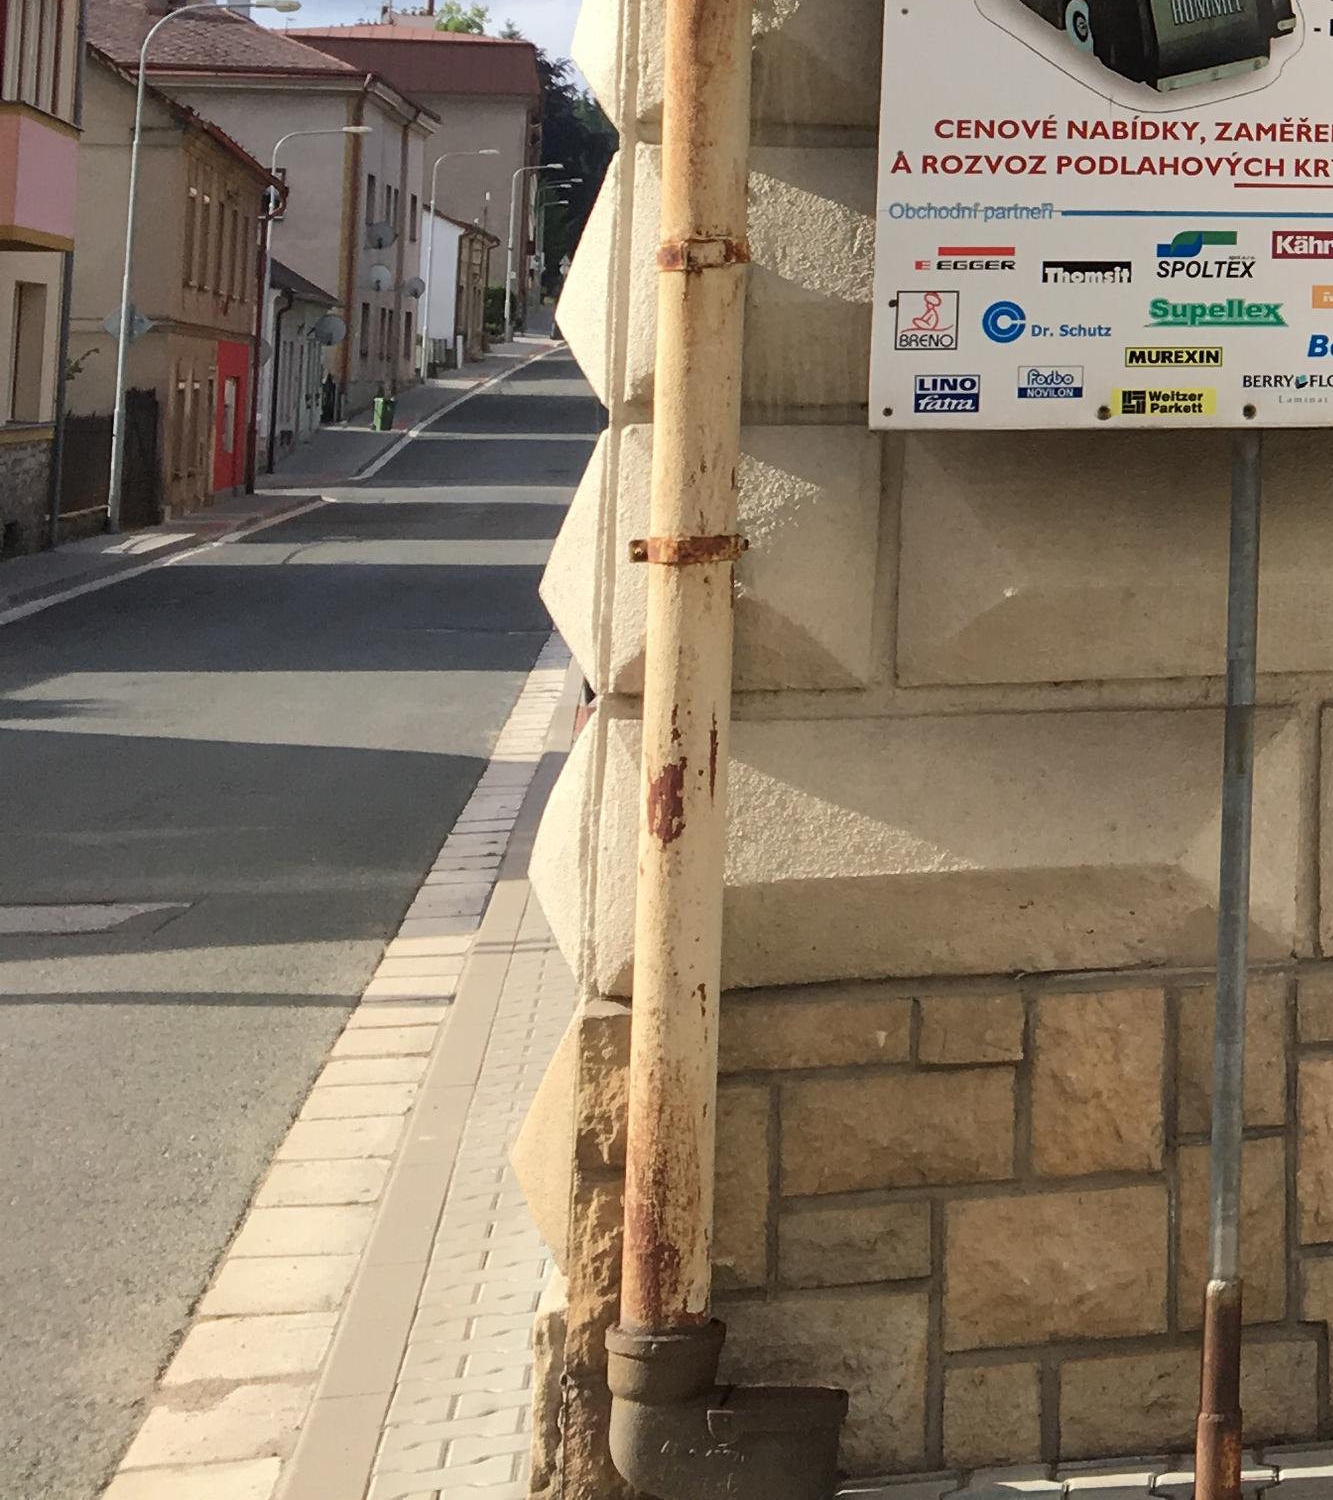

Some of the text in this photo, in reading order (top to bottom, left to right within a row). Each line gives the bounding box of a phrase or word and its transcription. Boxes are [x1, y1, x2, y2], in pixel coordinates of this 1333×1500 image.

[933, 114, 1058, 140] CENOVÉ
[1066, 115, 1206, 145] NABÍDKY,
[890, 154, 912, 175] A
[921, 154, 1047, 175] ROZVOZ
[1056, 152, 1285, 177] PODLAHOVÝCH
[888, 201, 981, 220] Obchodní
[936, 260, 1016, 271] EGGER
[1156, 260, 1256, 279] SPOLTEX
[1044, 266, 1131, 284] Thomsit
[1148, 297, 1286, 326] Supellex
[1031, 324, 1112, 338] Dr. Schutz
[898, 333, 954, 348] BRENO
[1127, 349, 1220, 365] MUREXIN
[917, 378, 977, 392] LINO
[1027, 368, 1074, 386] forbo
[1242, 374, 1295, 388] BERRY
[1026, 387, 1074, 398] NOVILON
[1148, 390, 1204, 402] Weitzer
[917, 394, 977, 411] fatra
[1149, 402, 1203, 414] Parkett
